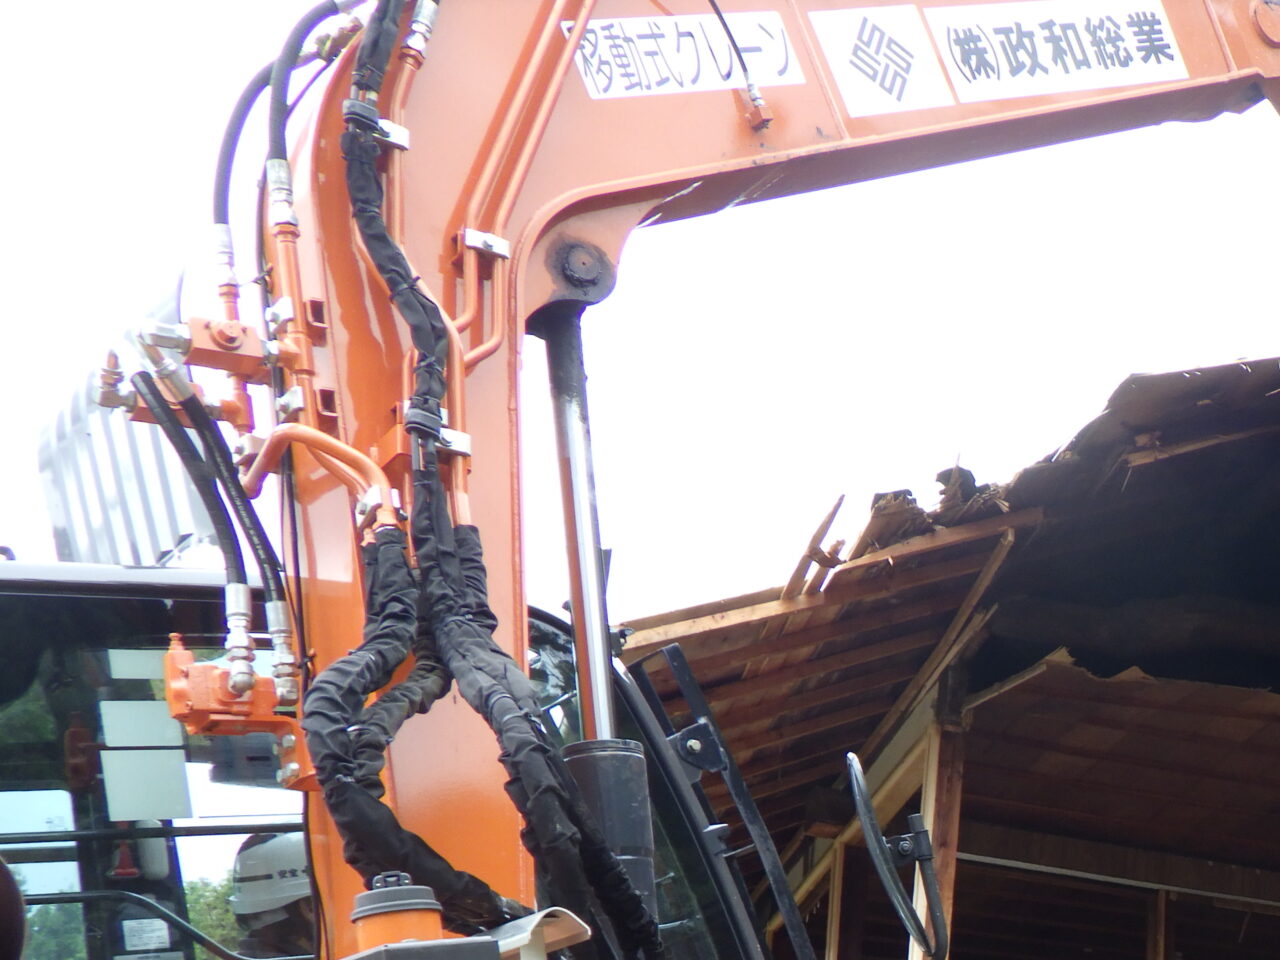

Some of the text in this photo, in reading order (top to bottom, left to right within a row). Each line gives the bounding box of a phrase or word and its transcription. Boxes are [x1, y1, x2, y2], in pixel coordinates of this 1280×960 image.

[946, 11, 1175, 84] (株)政和総業
